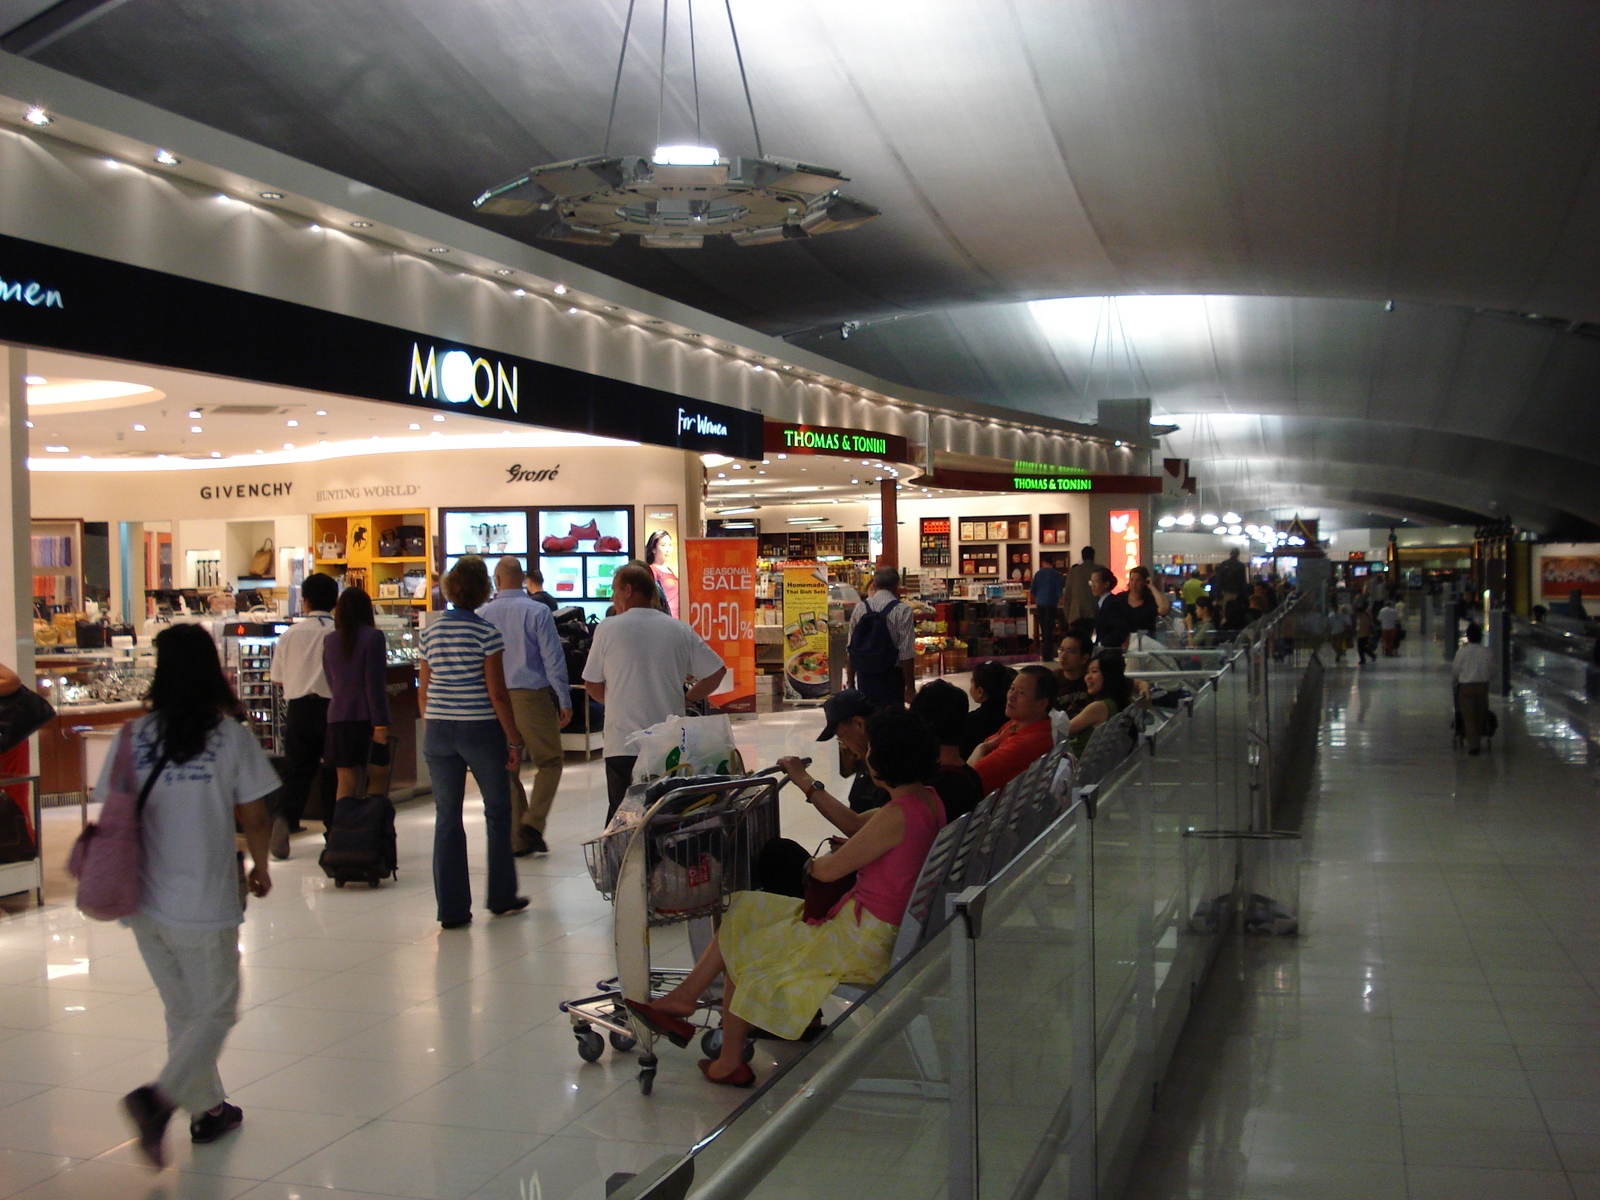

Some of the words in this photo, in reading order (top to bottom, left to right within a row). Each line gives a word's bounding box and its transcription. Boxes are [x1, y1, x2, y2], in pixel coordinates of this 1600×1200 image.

[409, 341, 518, 414] MOON
[678, 407, 696, 436] For
[697, 413, 727, 436] Women
[784, 430, 839, 450] THOMAS
[842, 434, 851, 451] &
[852, 436, 886, 454] TONINI
[200, 482, 293, 500] GIVENCHY
[316, 488, 360, 502] HUNTING
[363, 484, 417, 497] WORLD
[1014, 478, 1048, 490] THOMAS
[1049, 479, 1056, 490] &
[1057, 479, 1092, 490] TONINI
[703, 567, 751, 576] SEASONAL
[702, 575, 752, 590] SALE
